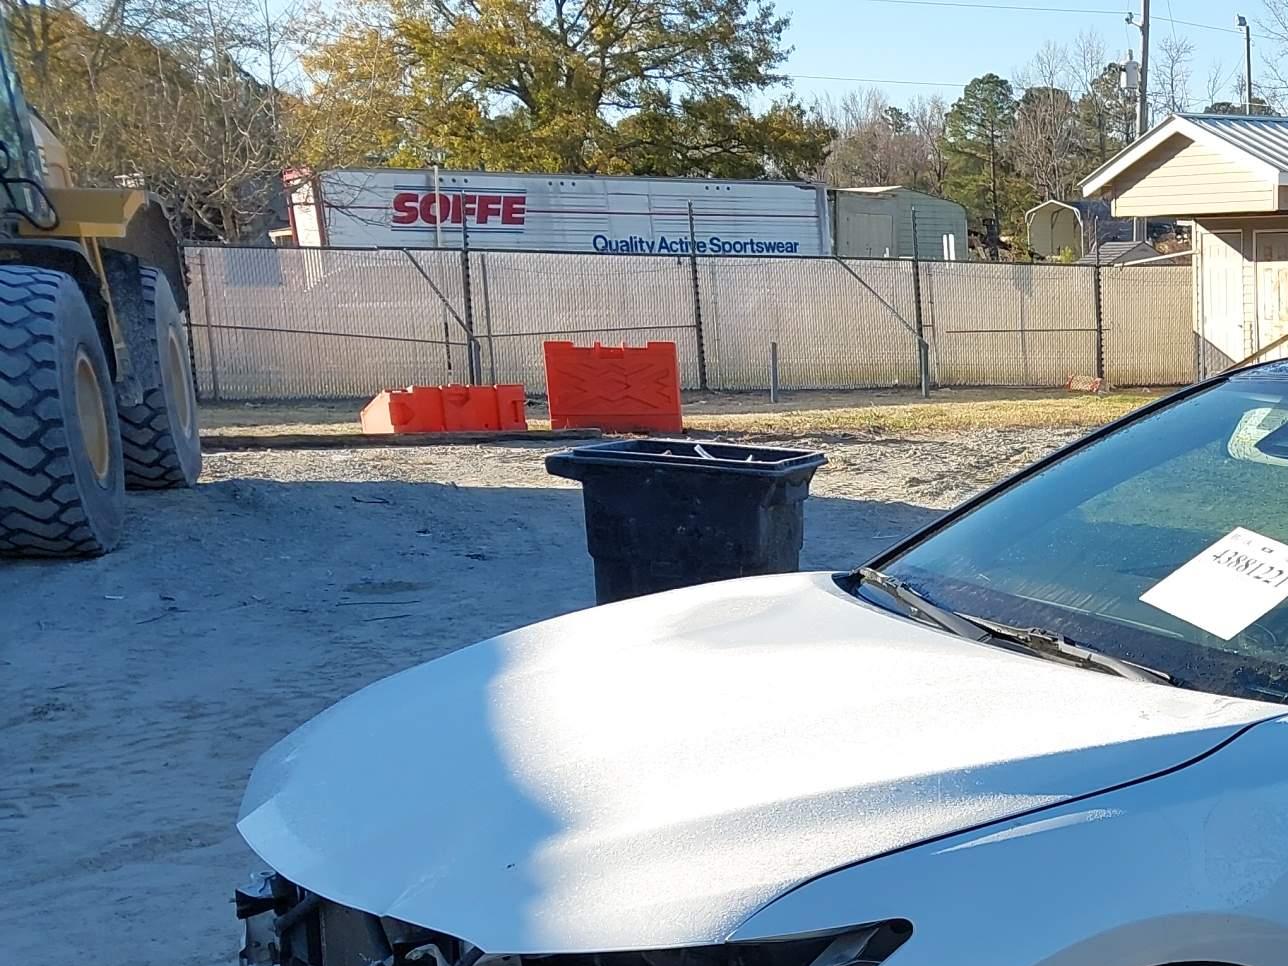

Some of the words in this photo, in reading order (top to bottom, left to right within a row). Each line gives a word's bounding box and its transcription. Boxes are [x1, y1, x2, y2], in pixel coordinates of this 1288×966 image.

[392, 192, 526, 224] SOFFE
[593, 235, 655, 254] Quality
[659, 236, 707, 253] Active
[710, 237, 800, 255] Sportswear
